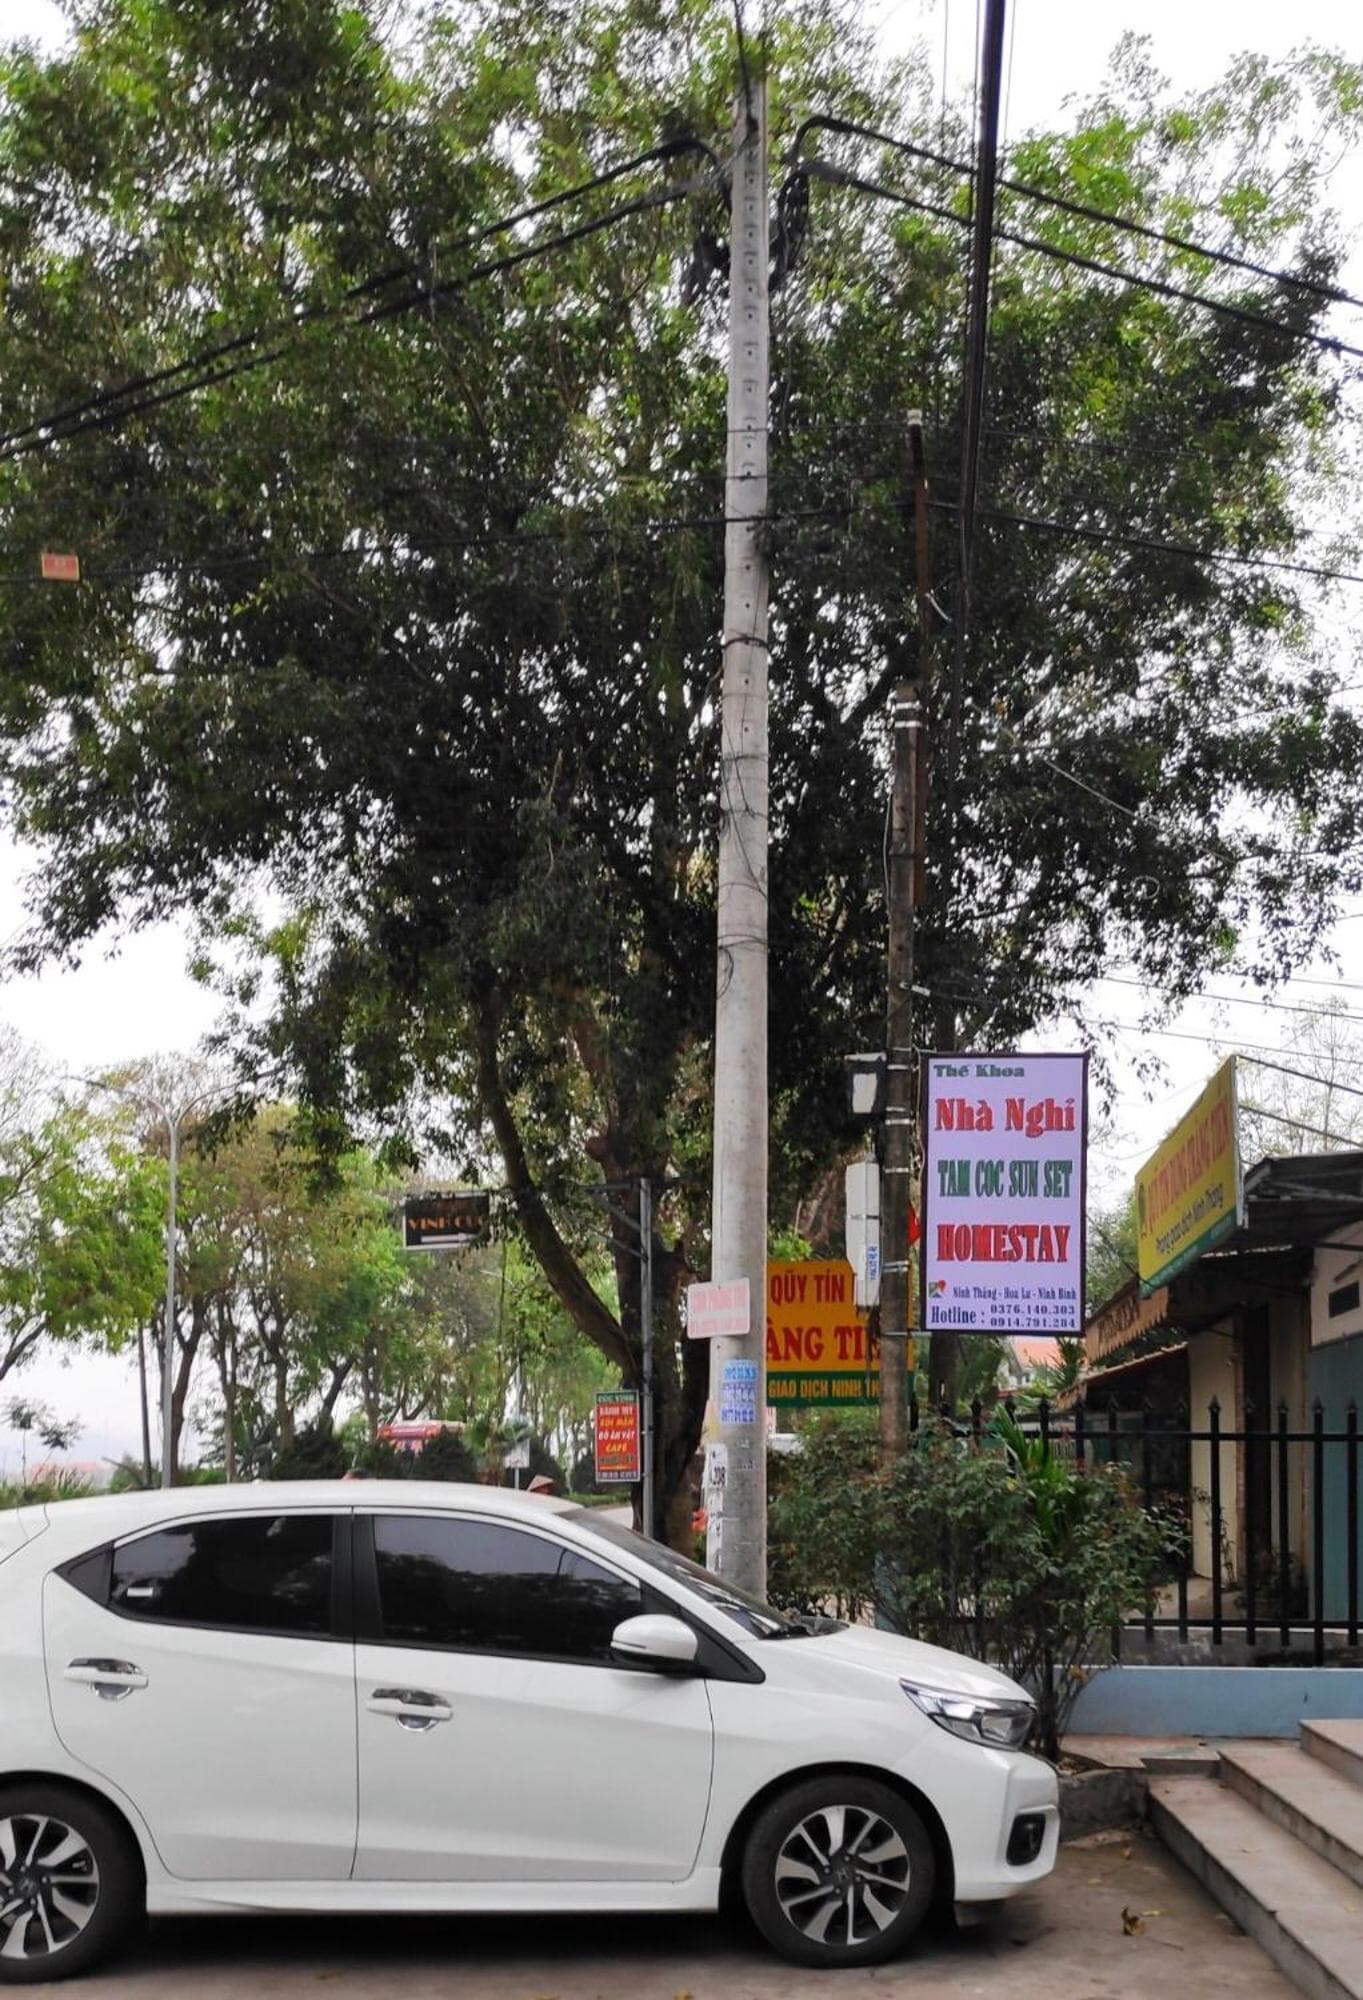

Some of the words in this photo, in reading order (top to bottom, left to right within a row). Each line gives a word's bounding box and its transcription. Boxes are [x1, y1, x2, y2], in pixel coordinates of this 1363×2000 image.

[934, 1064, 969, 1078] Thế
[976, 1065, 1025, 1078] Khoa
[934, 1098, 994, 1132] Nhà
[1004, 1098, 1076, 1138] Nghỉ
[938, 1160, 971, 1198] TAM
[975, 1160, 1004, 1198] COC
[1009, 1160, 1039, 1198] SUN
[1044, 1160, 1073, 1199] SET
[936, 1224, 1071, 1263] HOMESTAY
[770, 1270, 807, 1306] QUỸ
[813, 1269, 845, 1303] TÍN
[1004, 1287, 1019, 1299] Hoa
[931, 1306, 977, 1324] Hotline
[834, 1325, 880, 1361] TI
[768, 1380, 797, 1398] GIAO
[801, 1380, 828, 1400] DỊCH
